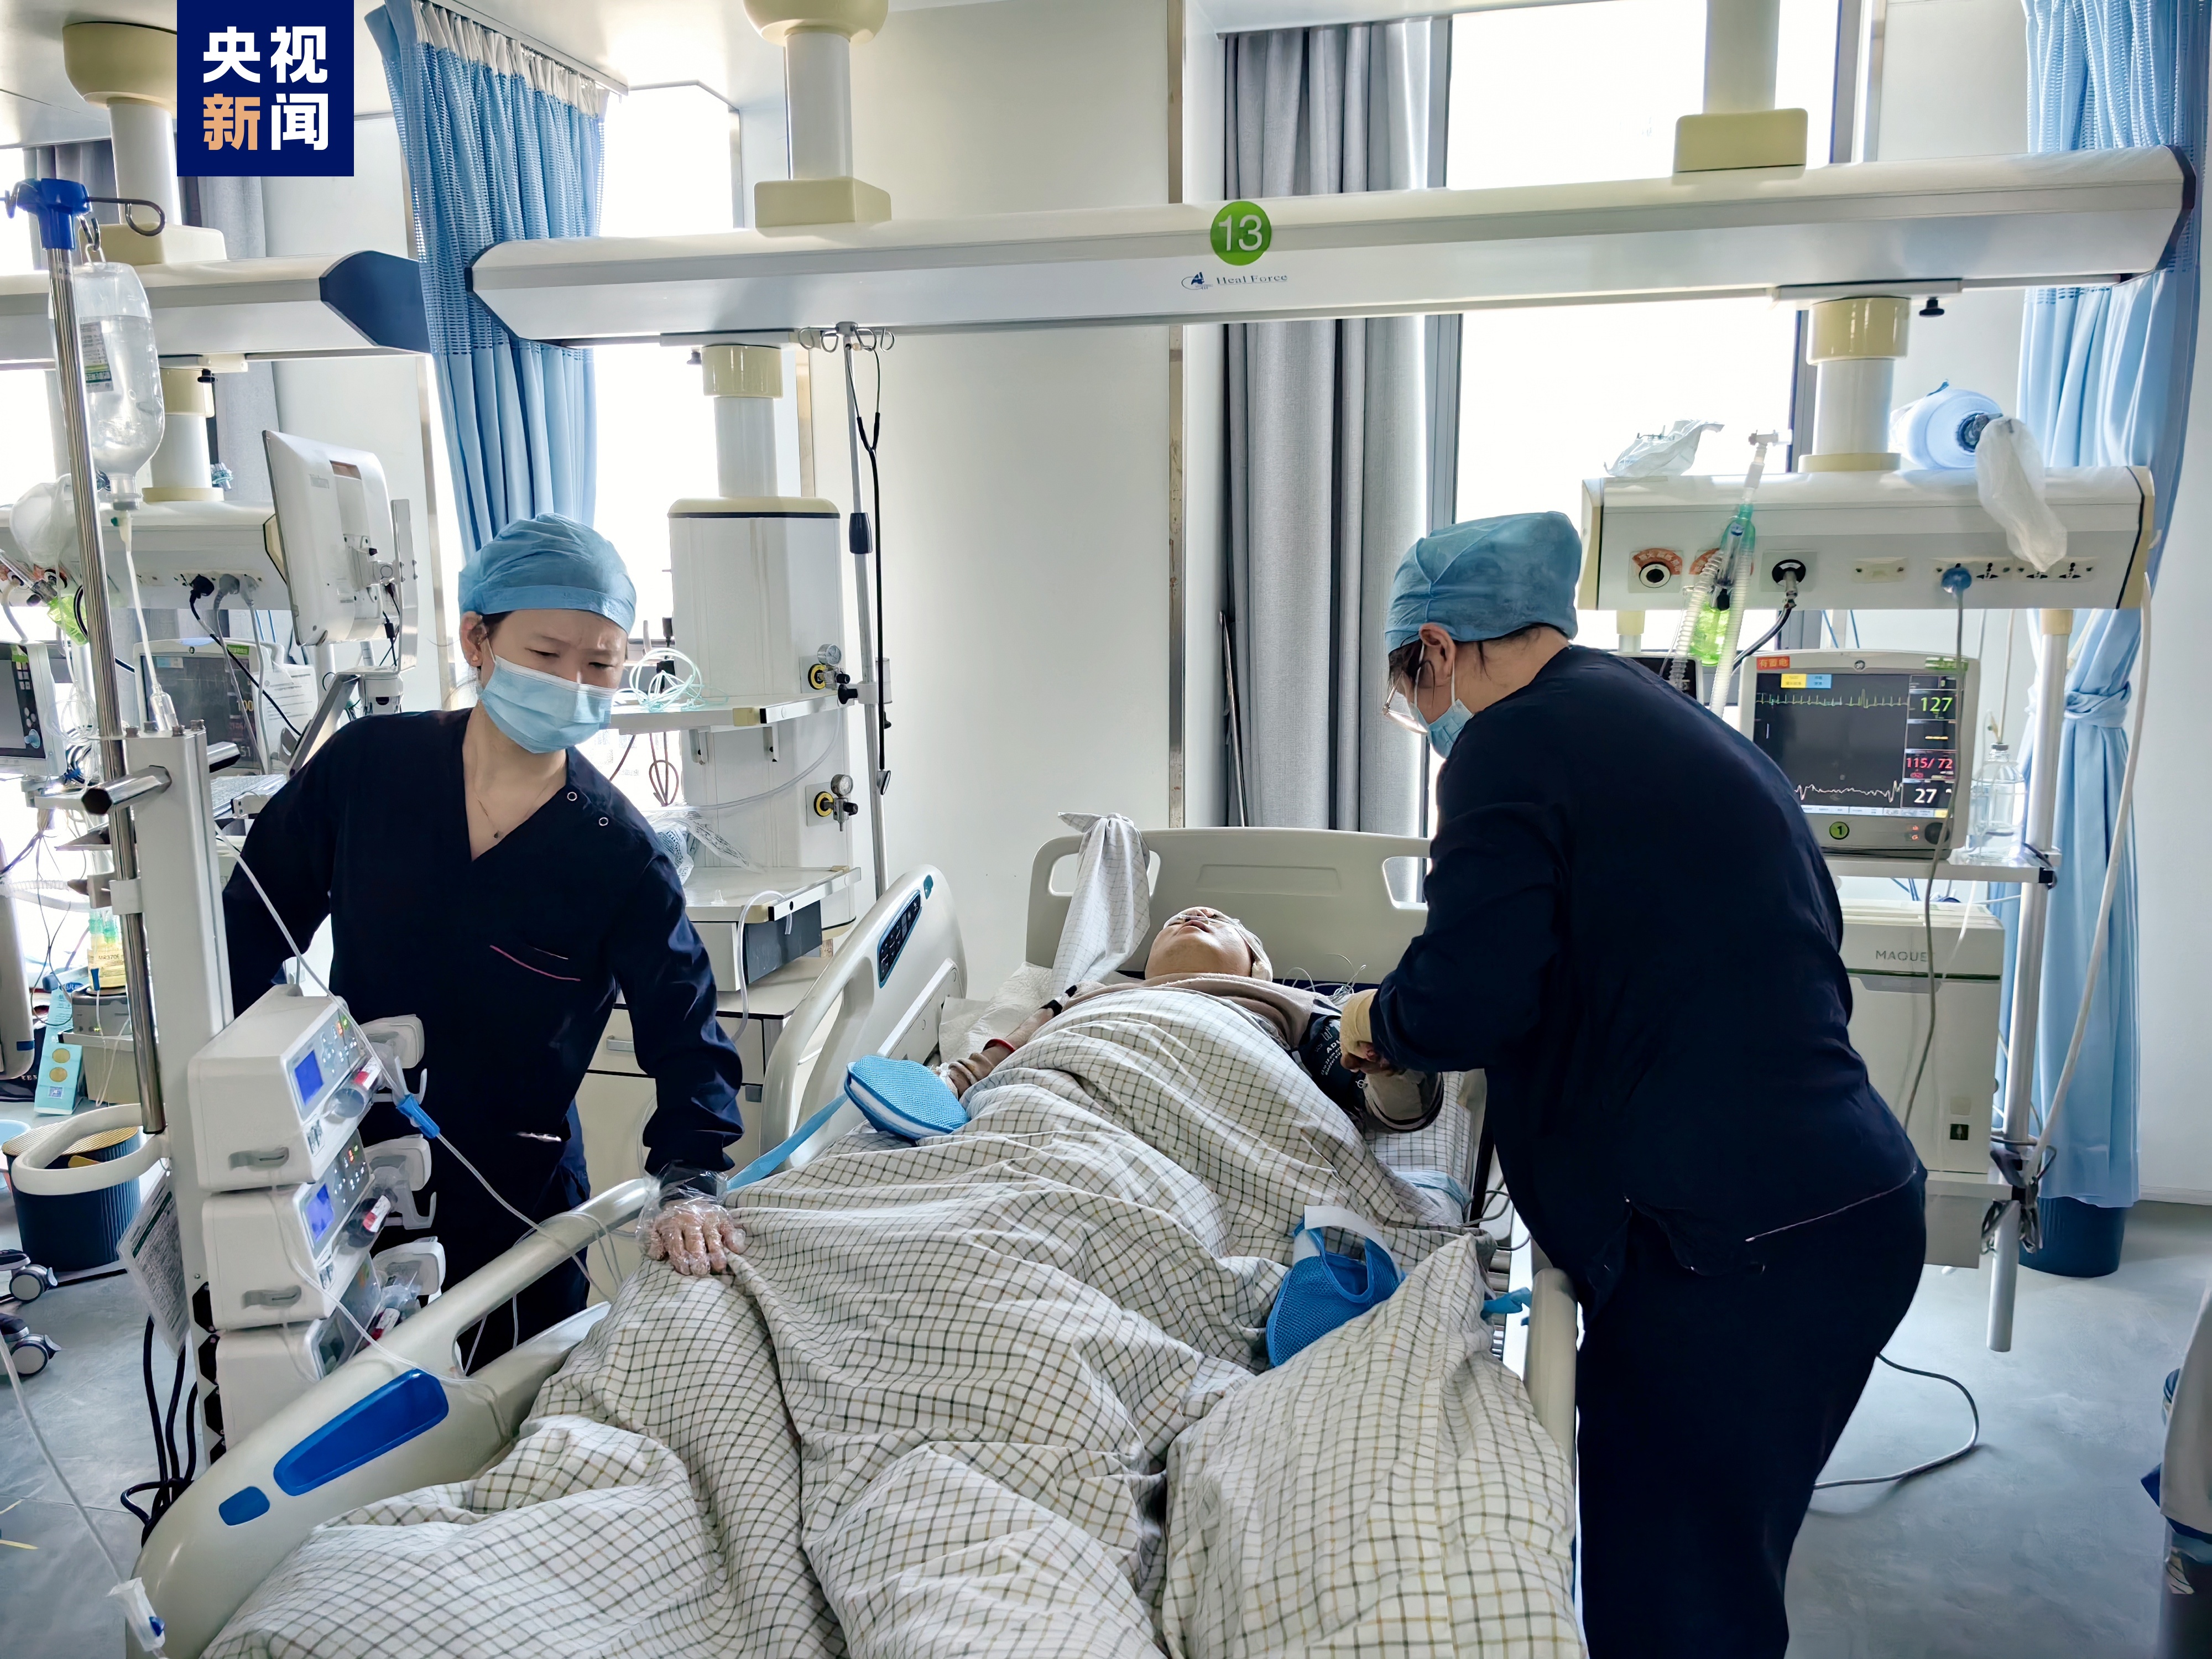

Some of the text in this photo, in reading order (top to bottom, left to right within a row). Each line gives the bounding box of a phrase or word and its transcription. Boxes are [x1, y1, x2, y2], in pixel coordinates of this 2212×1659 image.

[1218, 214, 1262, 252] 13
[1250, 274, 1288, 283] Force
[1921, 697, 1953, 712] 127
[1938, 759, 1953, 769] 72
[1914, 788, 1937, 804] 27
[1837, 826, 1843, 835] 1
[1875, 950, 1928, 962] MAQUE
